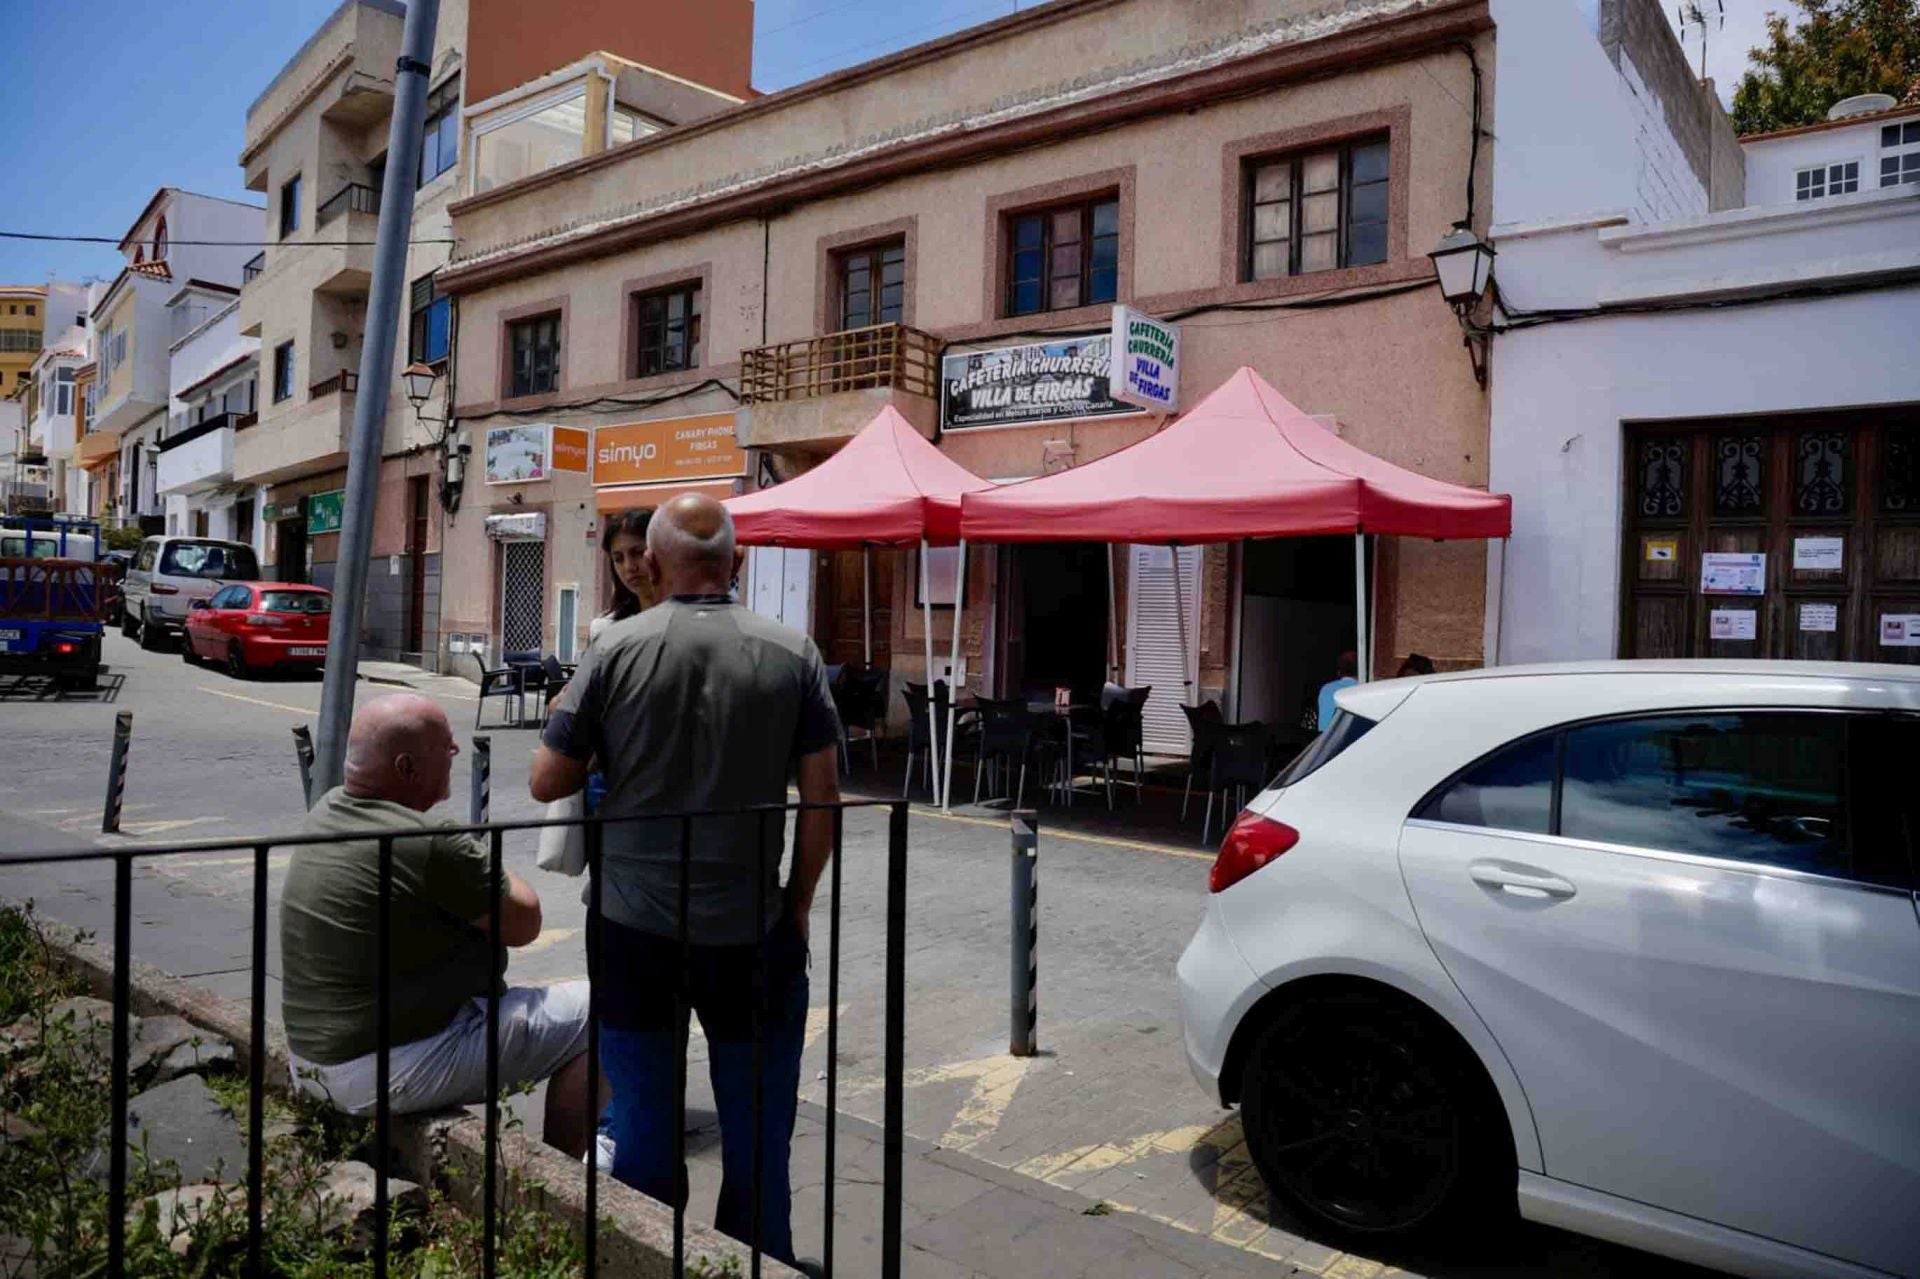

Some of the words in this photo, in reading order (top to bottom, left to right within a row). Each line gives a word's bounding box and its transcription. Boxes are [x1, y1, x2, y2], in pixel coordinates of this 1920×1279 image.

[1129, 321, 1174, 352] CAFETERÍA
[1128, 339, 1175, 370] CHURRERÍA
[1136, 356, 1160, 380] VILLA
[971, 386, 1013, 409] VILLA
[1014, 386, 1033, 403] DE
[1032, 377, 1095, 403] FIRGAS
[1129, 371, 1139, 384] DE
[1137, 378, 1171, 401] FIRGAS
[598, 441, 657, 468] simyo
